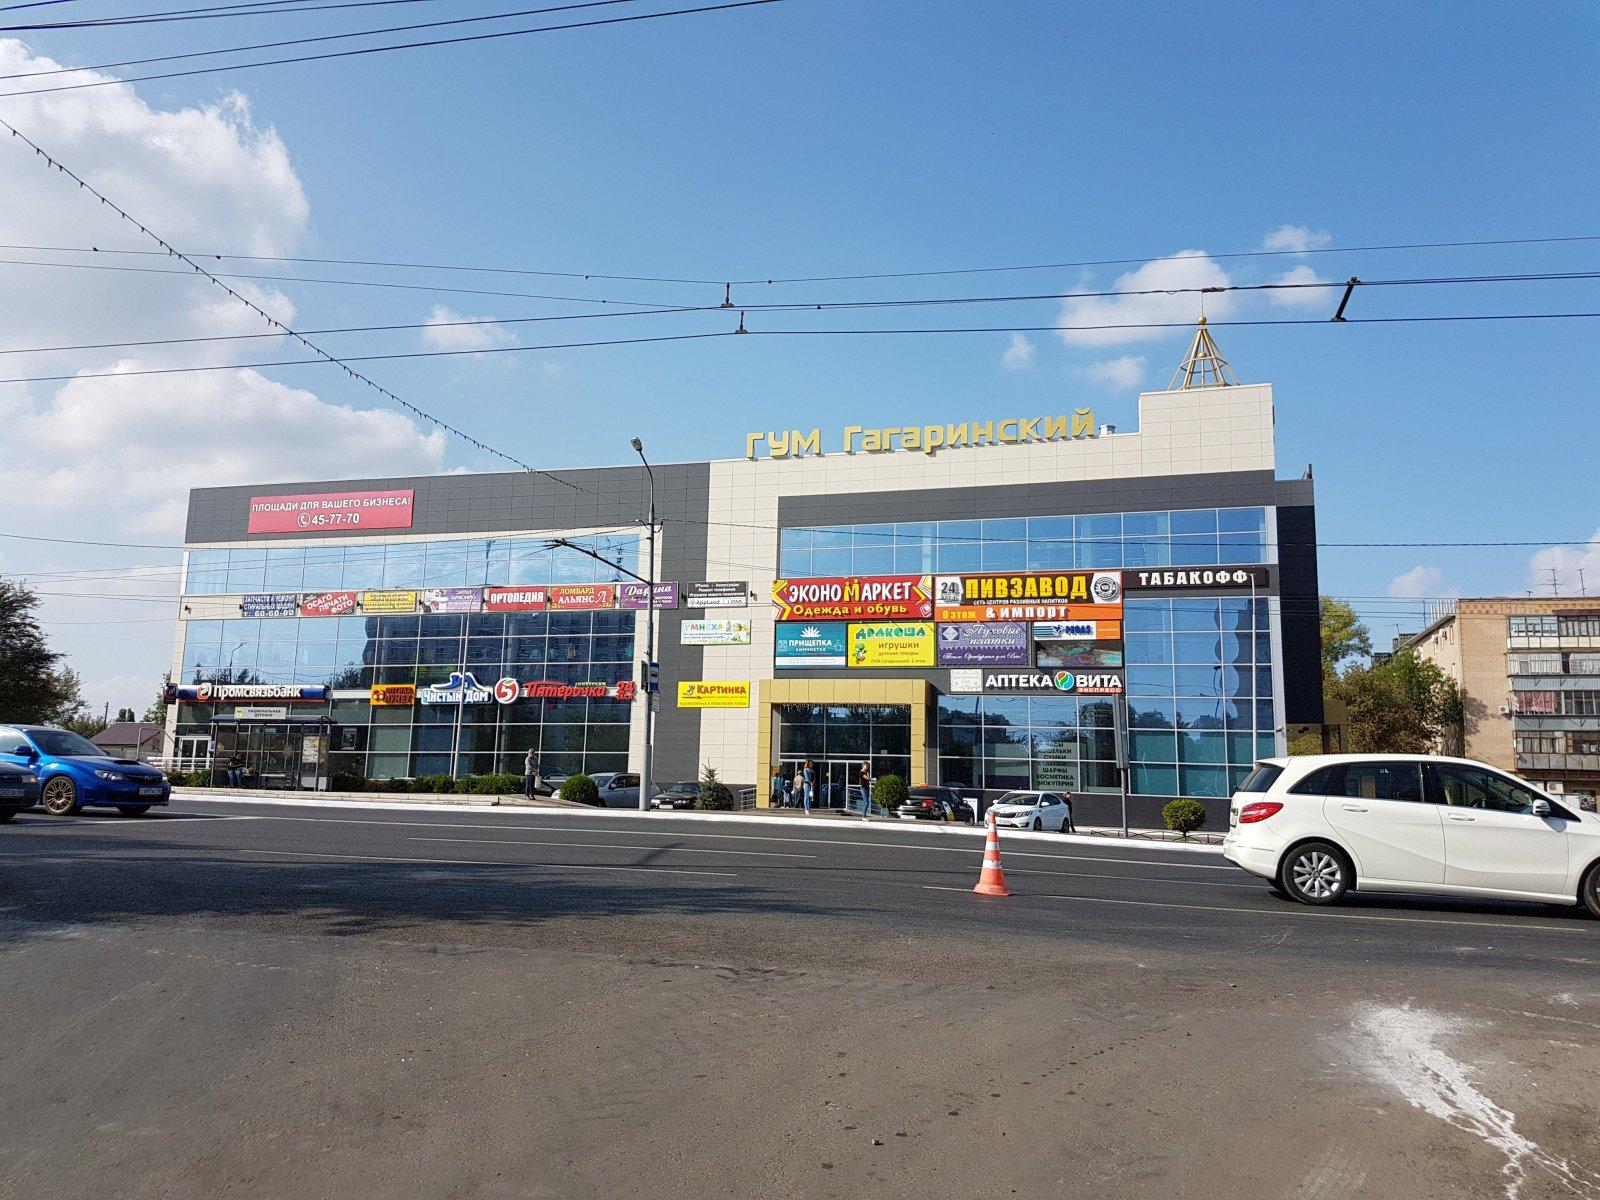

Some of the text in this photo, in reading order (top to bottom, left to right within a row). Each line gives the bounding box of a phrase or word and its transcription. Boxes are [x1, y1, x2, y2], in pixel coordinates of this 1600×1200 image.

[746, 407, 1095, 459] ГУМ Гагаринский
[252, 497, 411, 512] ПЛОЩАДИ ДЛЯ ВАШЕГО БИЗНЕСА!
[311, 513, 360, 525] 45-77-70
[1139, 570, 1248, 585] ТАБАКОФФ
[559, 587, 595, 595] ЛОМБАРД
[941, 582, 956, 593] 24
[965, 576, 1088, 599] ПИВЗАВОД
[307, 594, 332, 610] ОСАГО
[319, 594, 349, 612] ПЕЧАТИ
[490, 592, 544, 604] ОРТОПЕДИЯ
[558, 596, 595, 604] АЛЬЯНС
[331, 599, 353, 613] ФОТО
[793, 605, 849, 616] Одежда
[867, 604, 907, 616] обувь
[985, 607, 995, 618] &
[855, 627, 926, 640] ДРАКОША
[1065, 625, 1093, 634] PEGAS
[878, 642, 919, 650] игрушки
[985, 674, 1054, 687] АПТЕКА
[1076, 675, 1122, 687] ВИТА
[213, 684, 302, 700] Промсвязьбанк
